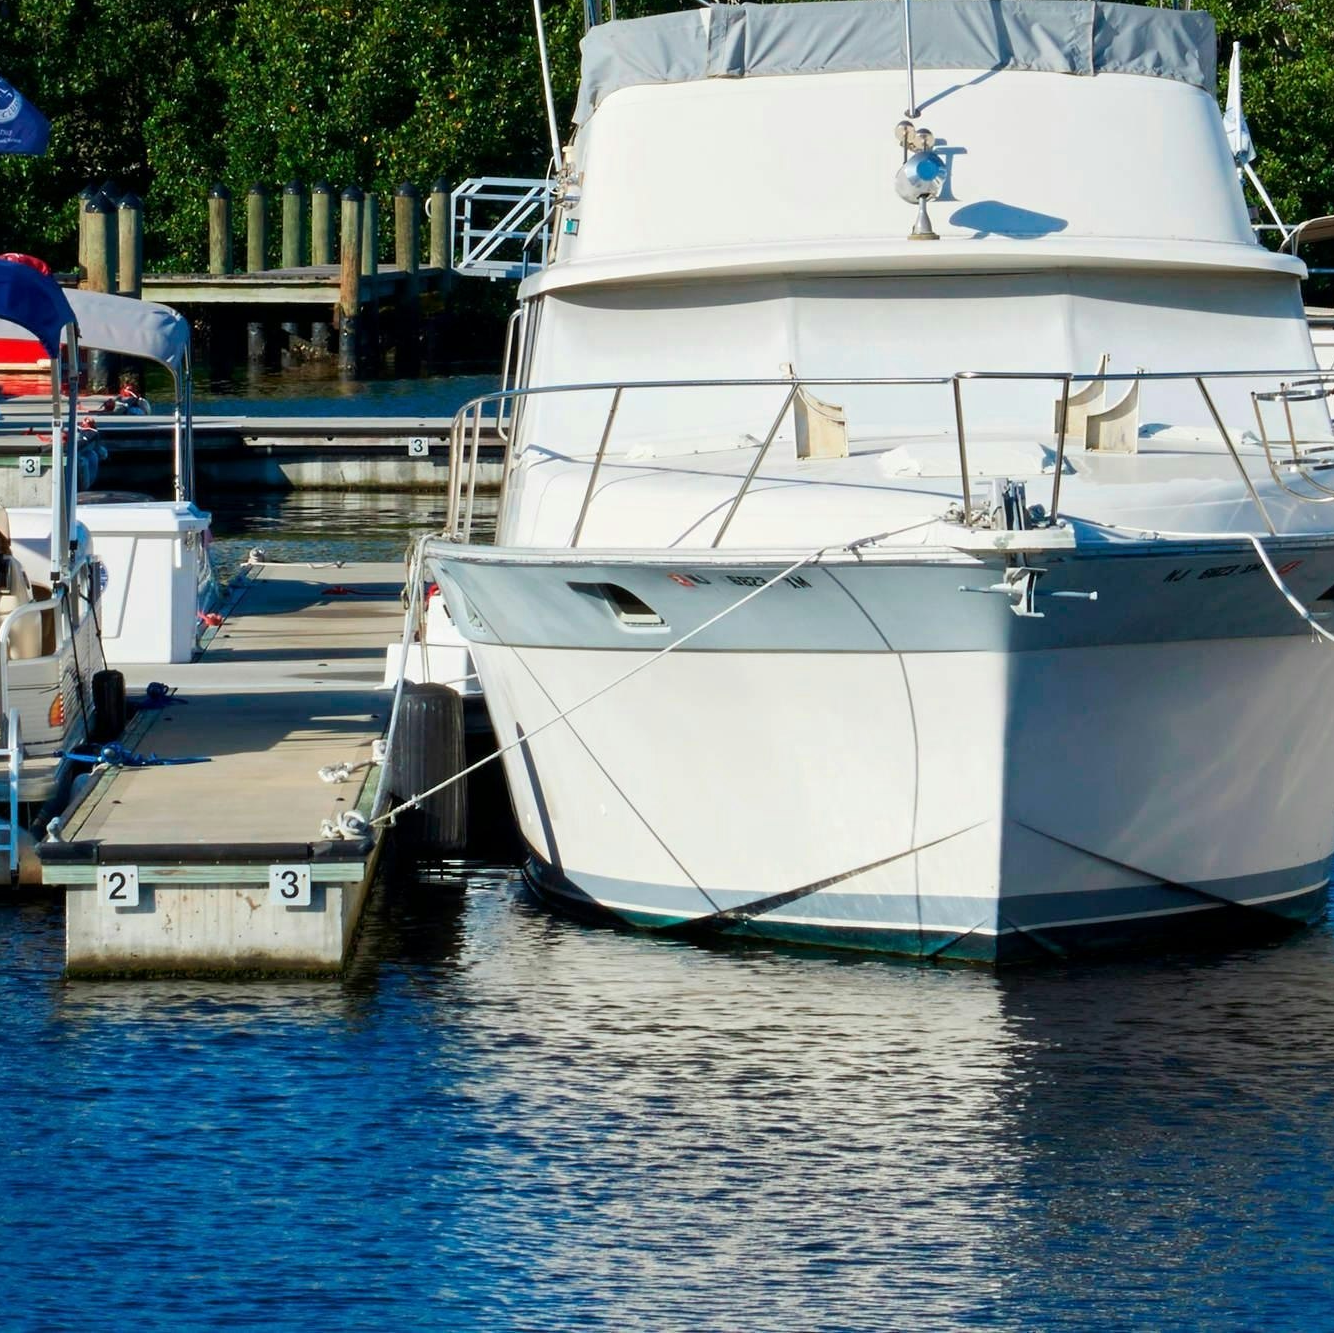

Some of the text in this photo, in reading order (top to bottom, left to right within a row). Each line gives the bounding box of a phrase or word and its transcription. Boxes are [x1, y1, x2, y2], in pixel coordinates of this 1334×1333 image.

[413, 438, 423, 453] 3
[25, 458, 36, 474] 3
[108, 872, 128, 901] 2
[280, 870, 300, 899] 3
